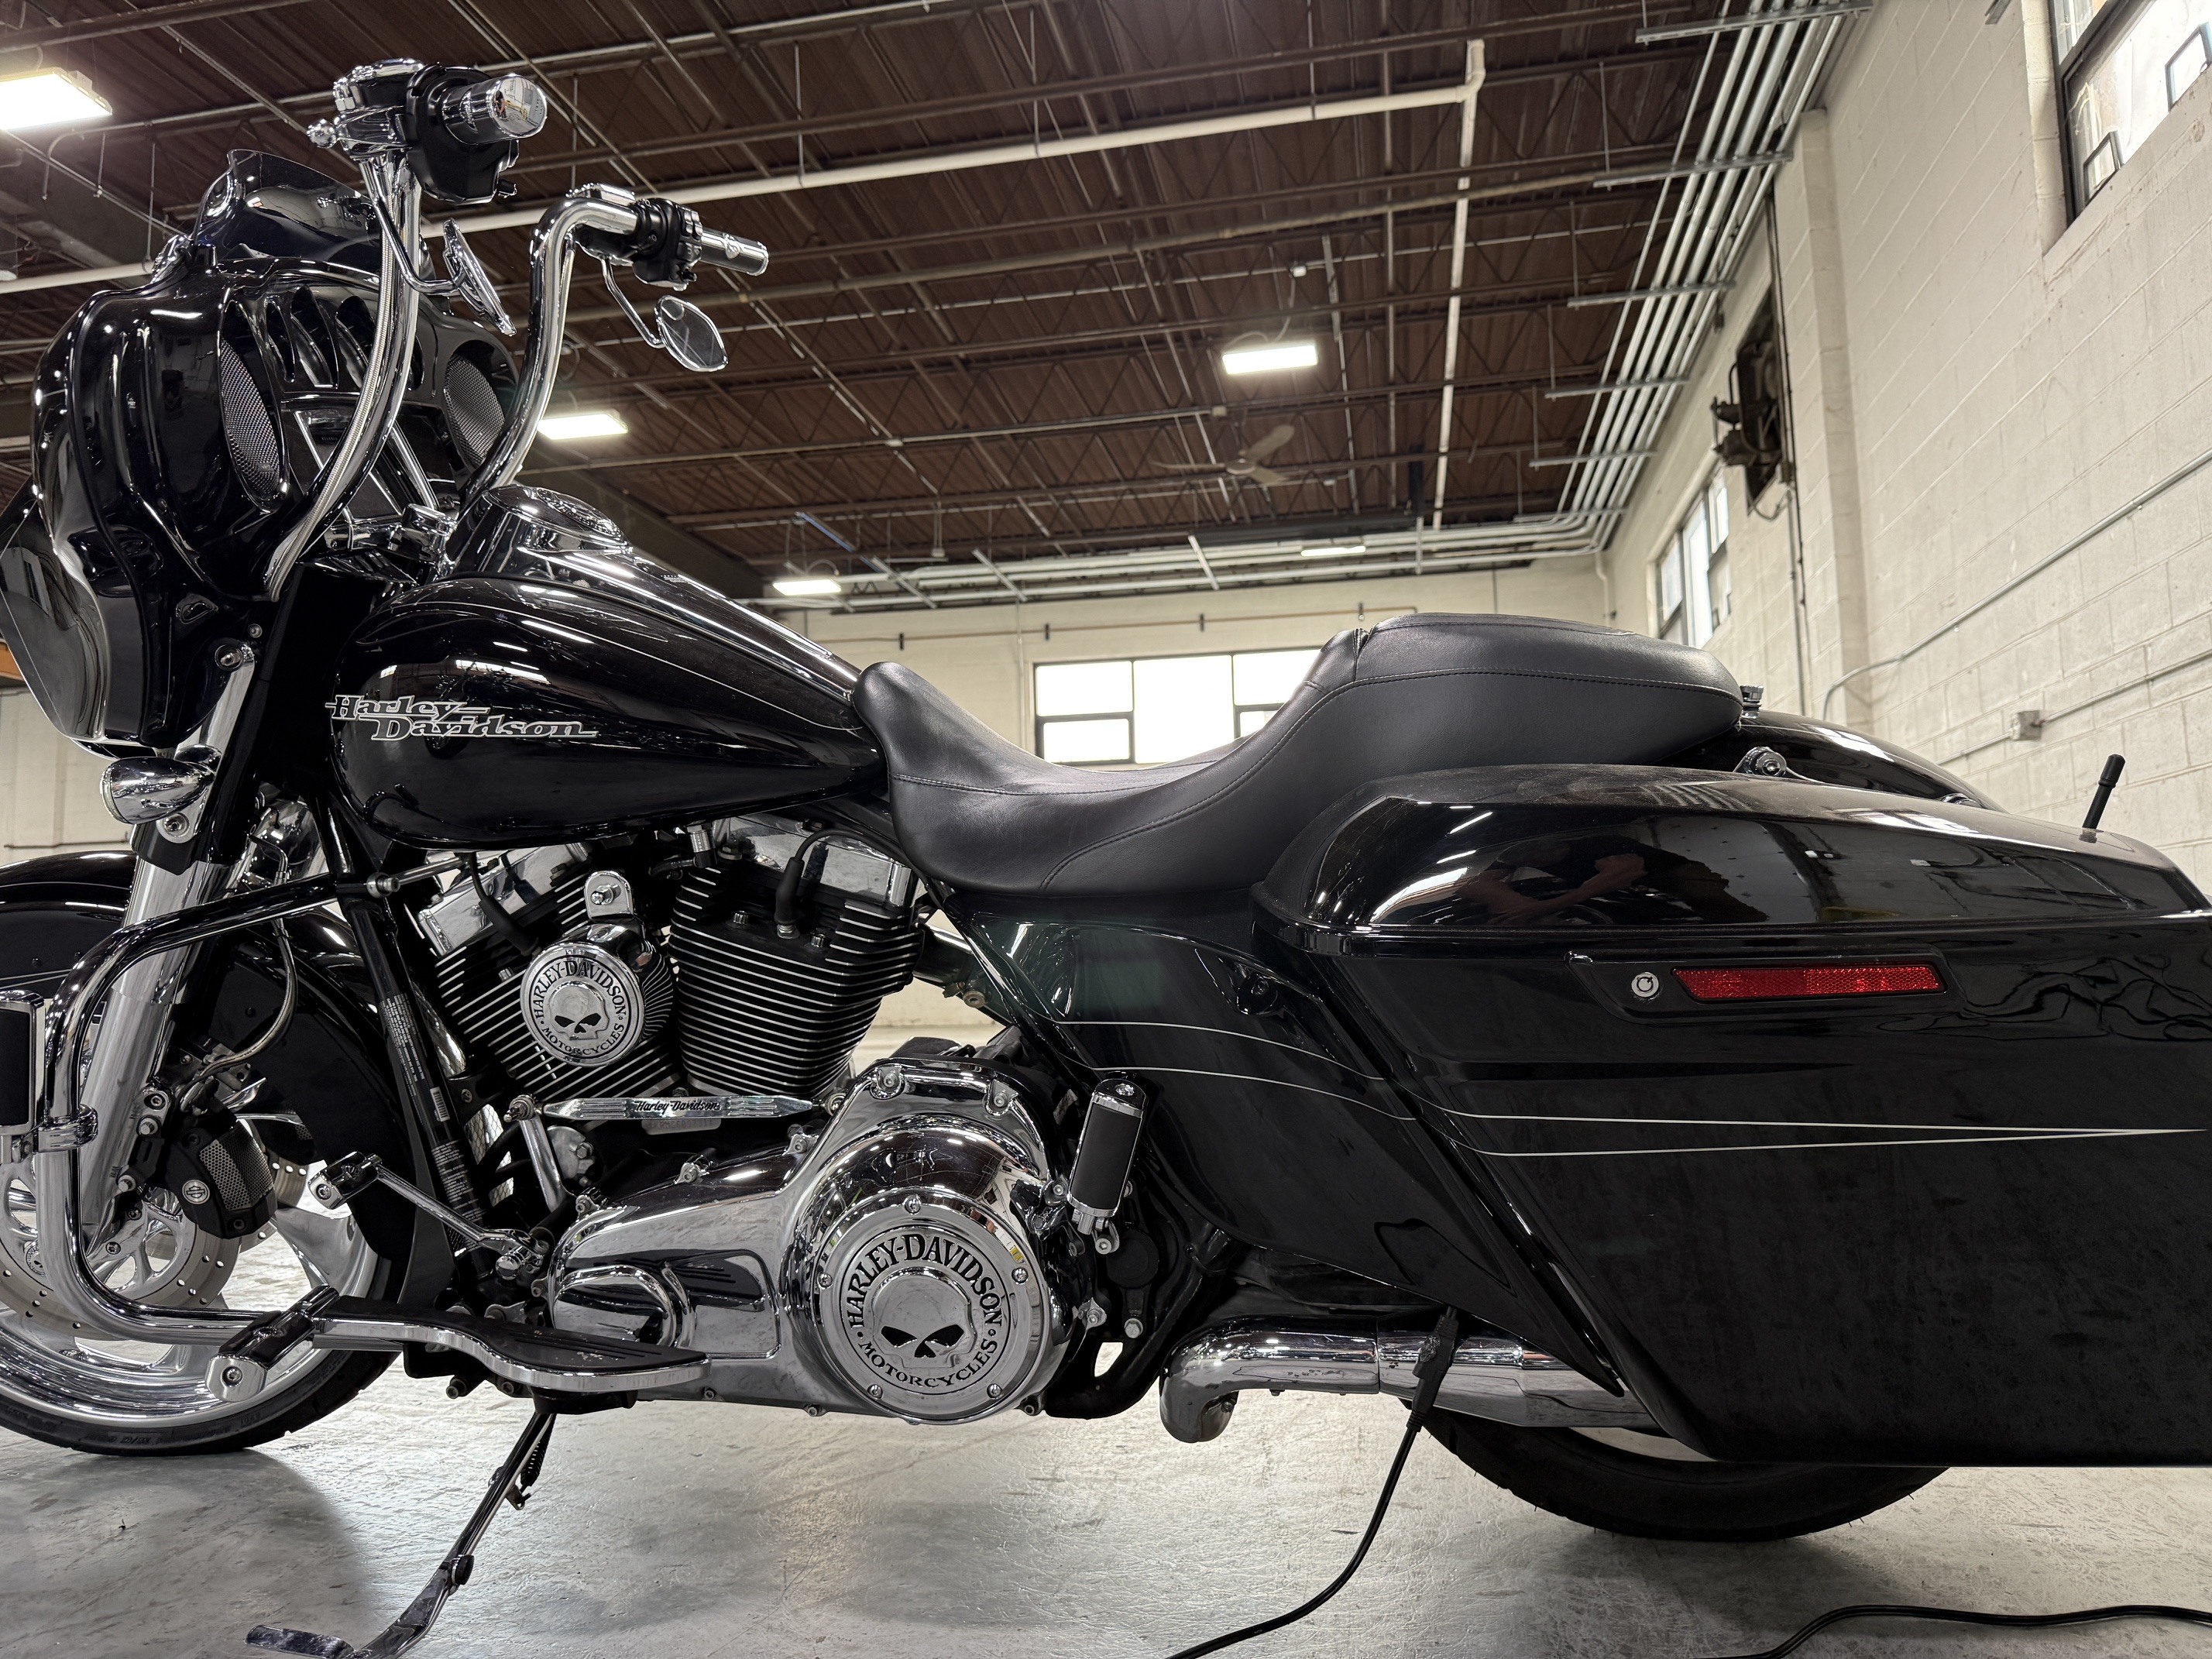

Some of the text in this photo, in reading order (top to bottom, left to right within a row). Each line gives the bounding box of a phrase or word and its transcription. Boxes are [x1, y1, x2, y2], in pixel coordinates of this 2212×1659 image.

[325, 694, 491, 722] Harley
[359, 714, 599, 740] Davidson
[532, 960, 627, 1018] HARLEY-DAVIDSON
[542, 1023, 624, 1056] MOTORCYCLES
[847, 1233, 1003, 1329] HARLEY-DAVIDSON
[858, 1338, 998, 1388] MOTORCYCLES
